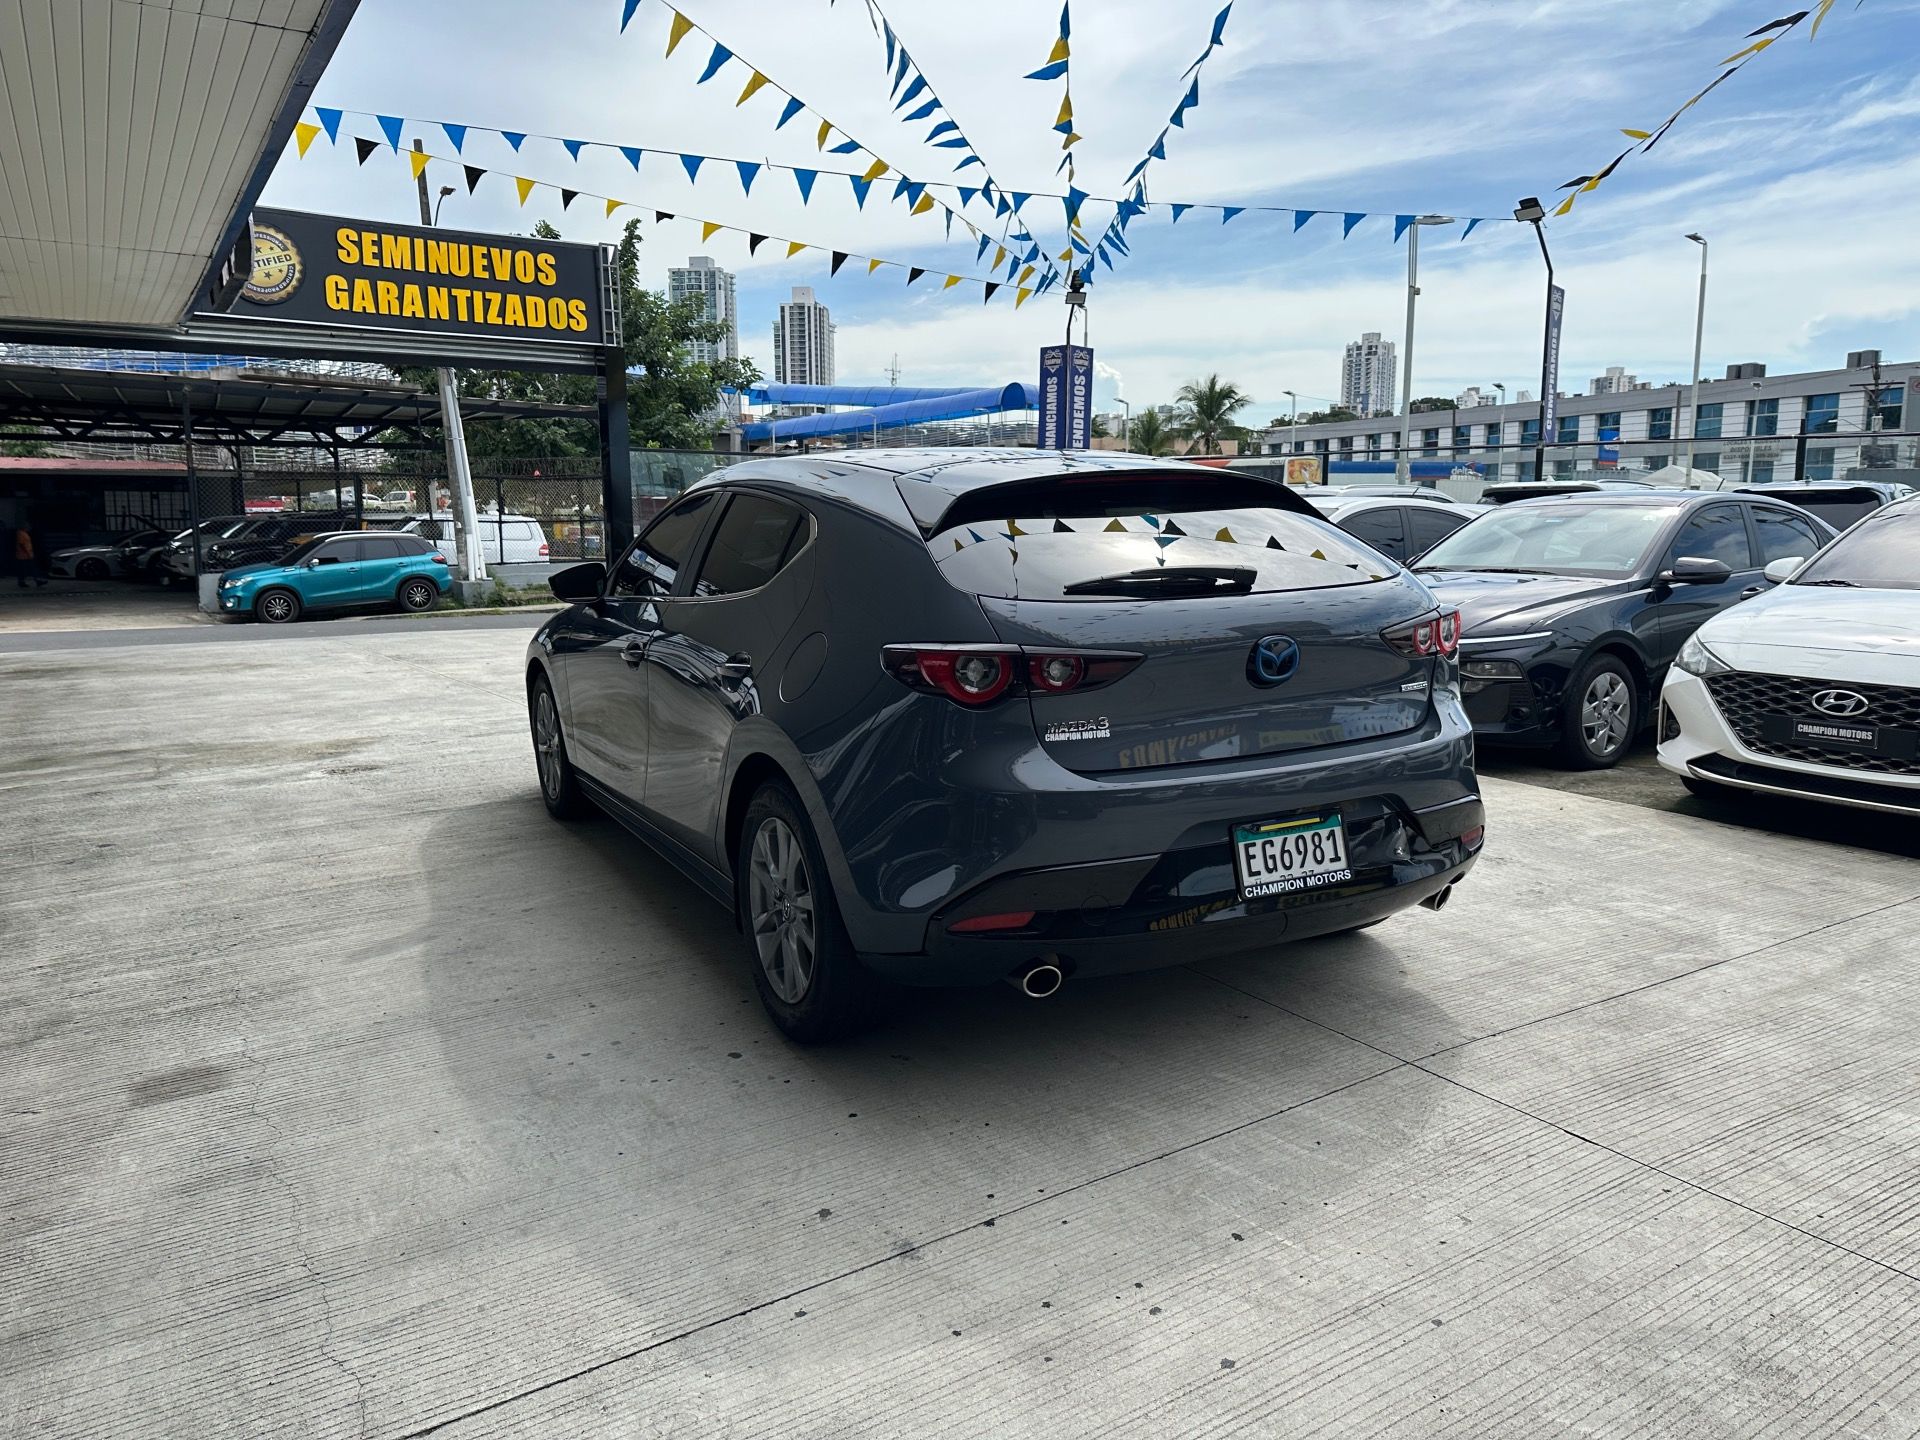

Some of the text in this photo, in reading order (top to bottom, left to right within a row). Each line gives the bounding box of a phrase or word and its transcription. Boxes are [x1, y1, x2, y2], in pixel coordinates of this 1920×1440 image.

[254, 254, 292, 268] TIFIED
[336, 228, 557, 287] SEMINUEVOS
[325, 275, 588, 332] GARANTIZADOS
[1546, 327, 1558, 431] COMPRAMOS
[1045, 376, 1058, 450] INANCIAMOS
[1072, 375, 1086, 448] ENDEMOS
[1450, 465, 1474, 476] delta
[1044, 729, 1111, 742] CHAMPION MOTORS
[1797, 723, 1838, 737] CHAMPION
[1839, 728, 1873, 740] MOTORS
[1243, 829, 1342, 878] EG6981
[1244, 878, 1305, 898] CHAMPION
[1306, 869, 1352, 887] MOTORS
